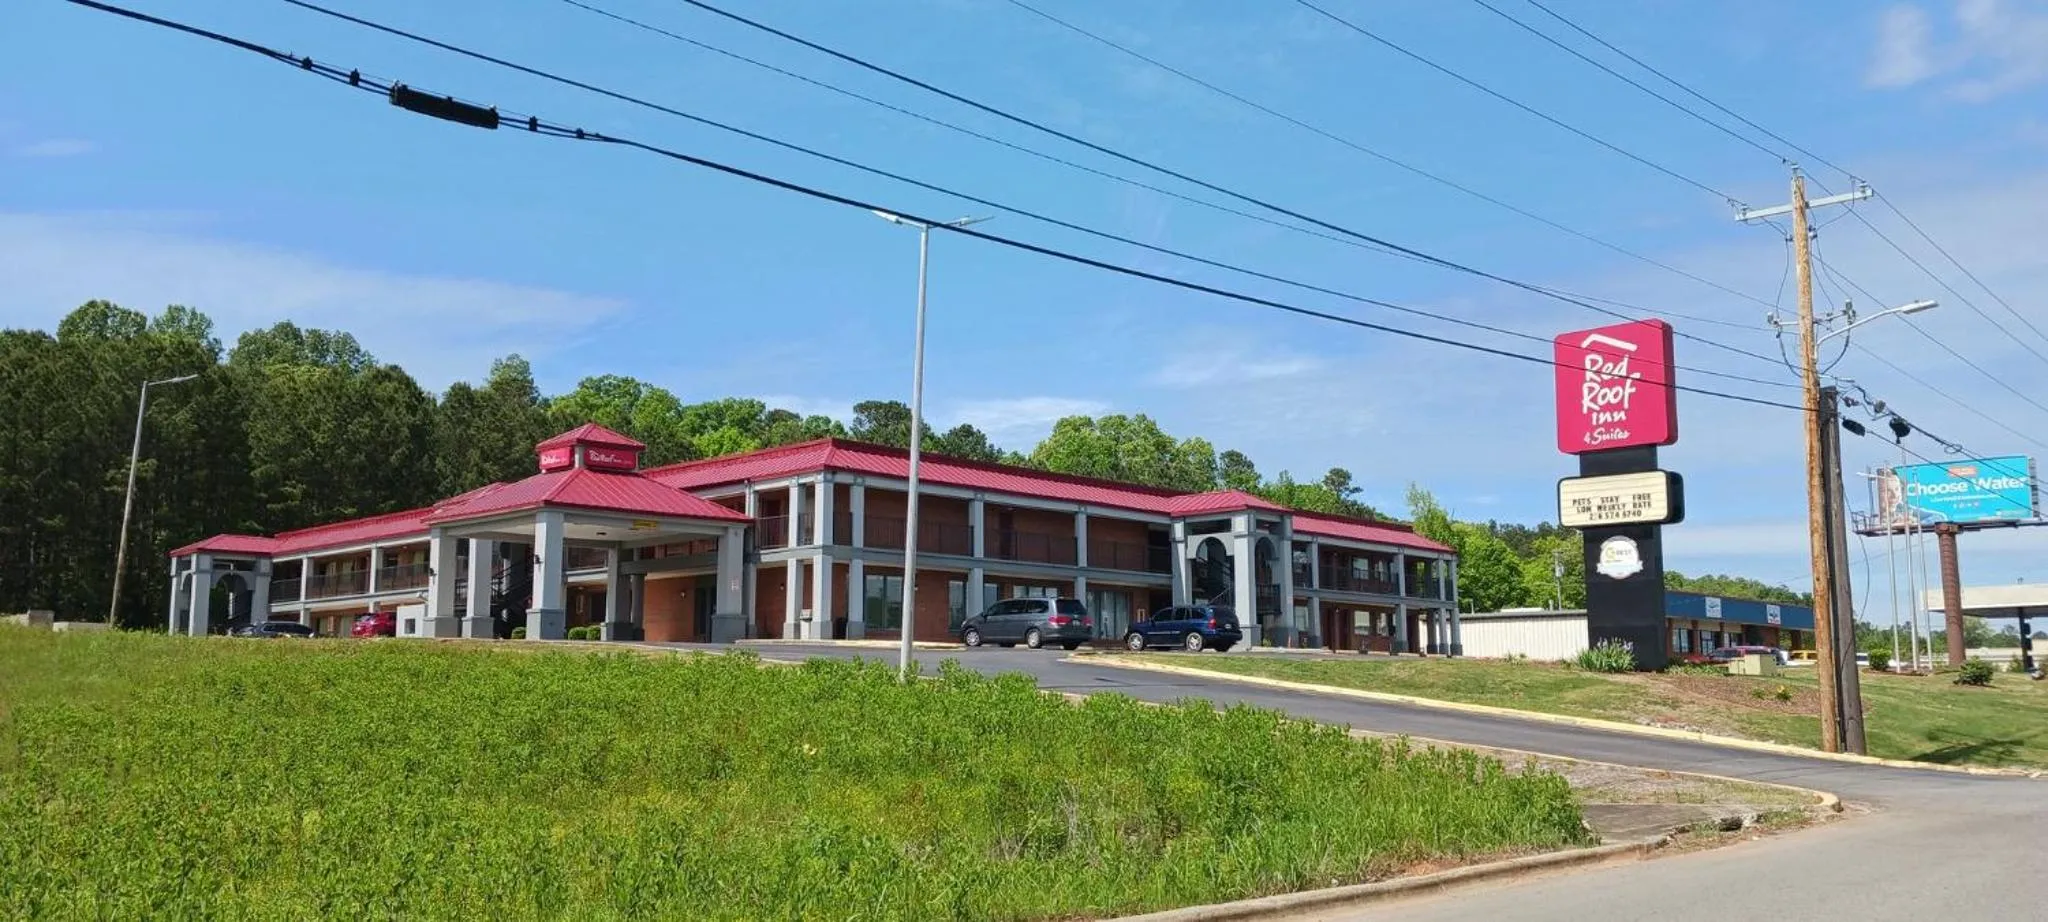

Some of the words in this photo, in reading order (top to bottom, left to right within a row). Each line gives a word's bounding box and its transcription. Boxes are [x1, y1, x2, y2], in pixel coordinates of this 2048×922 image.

[1585, 354, 1629, 382] Red
[1582, 372, 1641, 414] Roof
[1591, 427, 1630, 445] Suites
[1906, 482, 1969, 497] Choose
[1972, 475, 2029, 491] Water
[1573, 498, 1591, 506] PETS
[1600, 496, 1619, 504] STAY
[1633, 493, 1651, 501] FREE
[1597, 503, 1626, 511] WEEKLY
